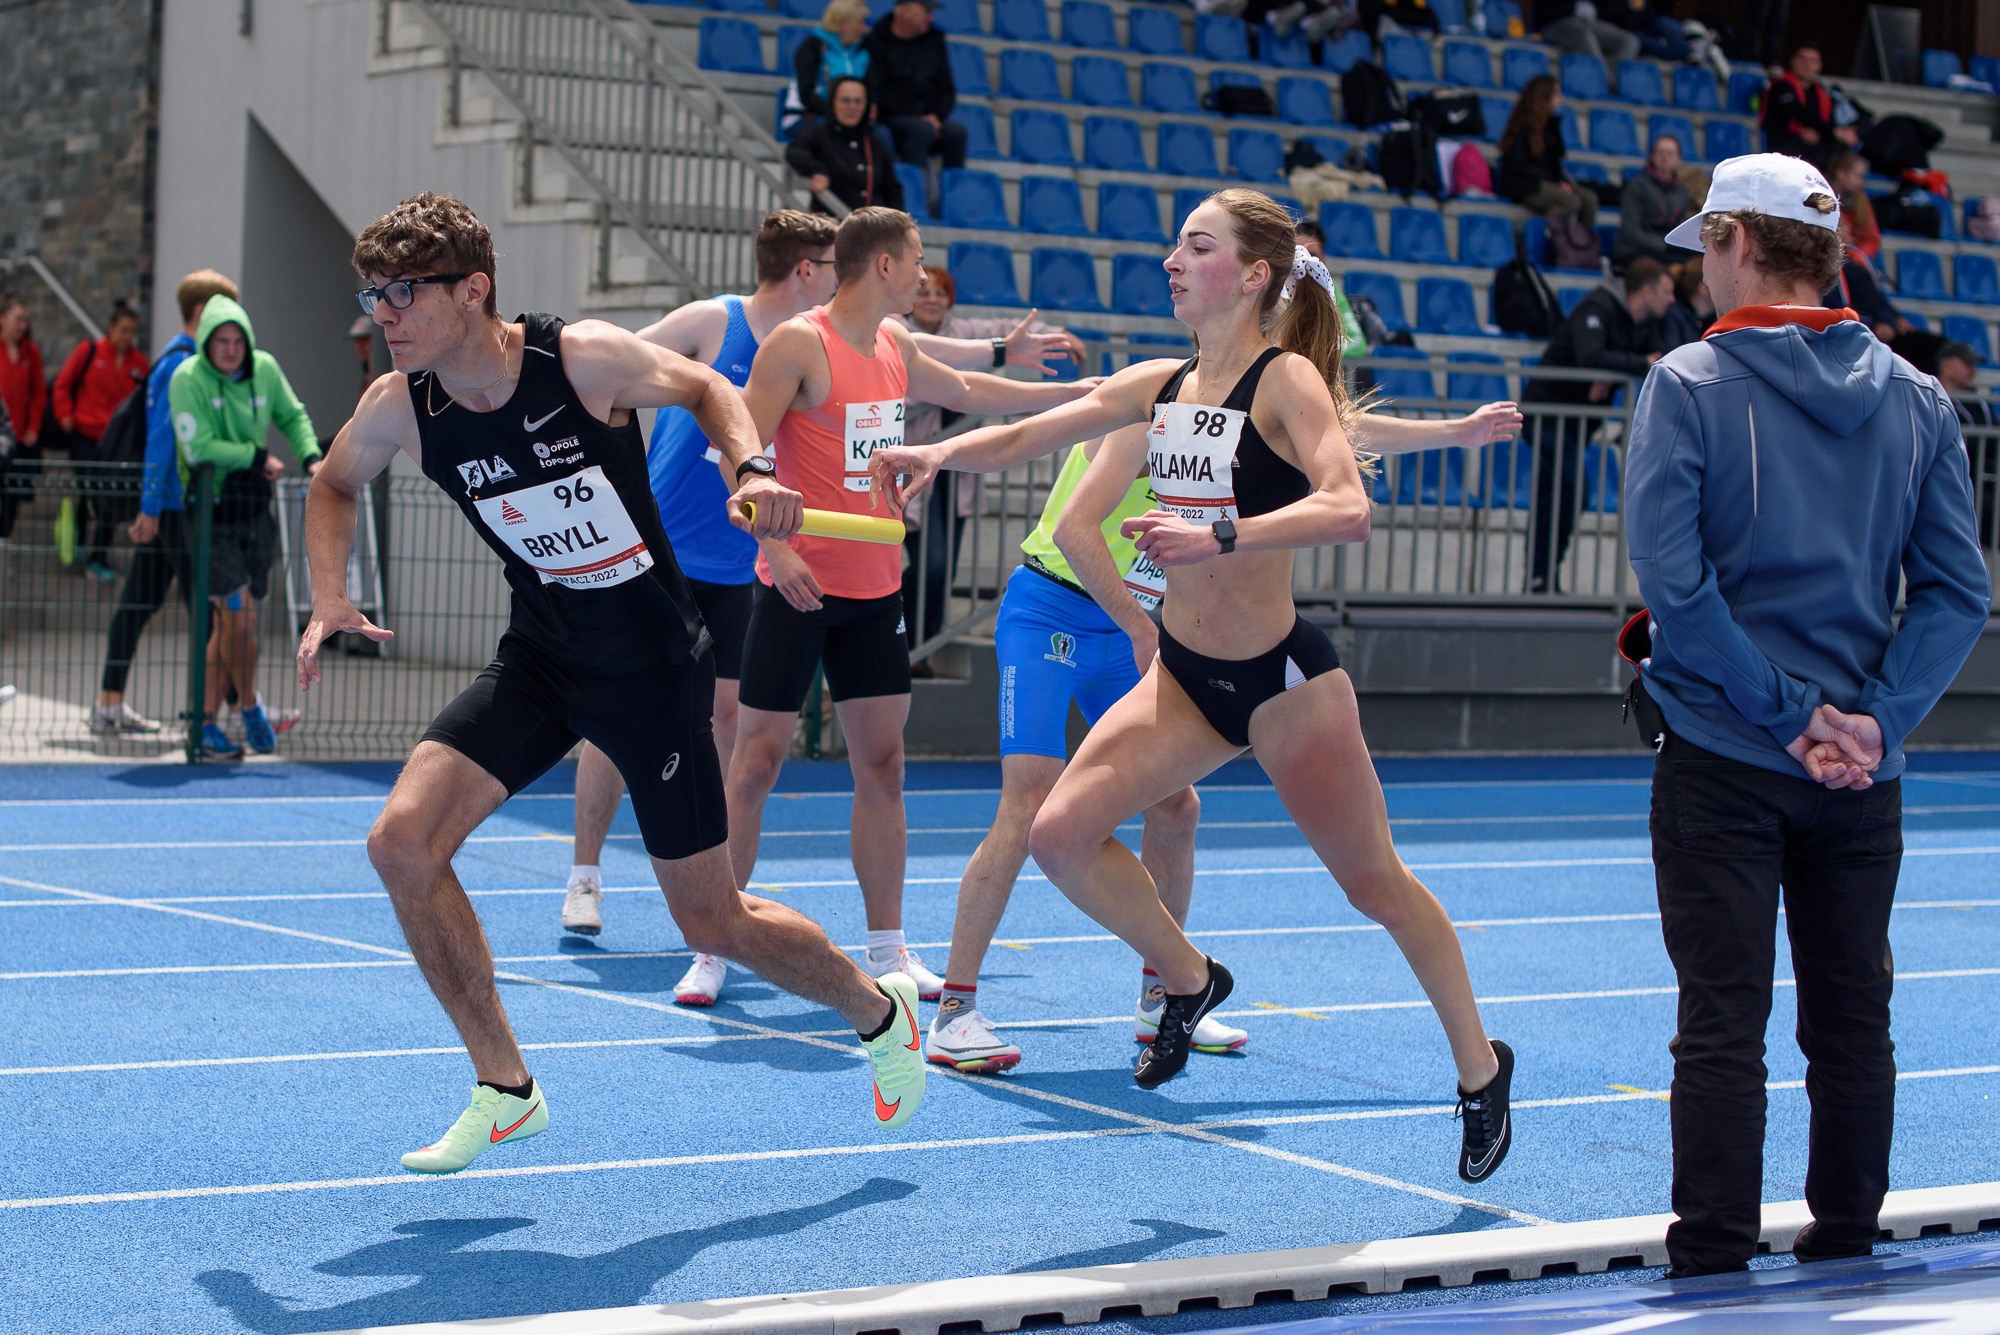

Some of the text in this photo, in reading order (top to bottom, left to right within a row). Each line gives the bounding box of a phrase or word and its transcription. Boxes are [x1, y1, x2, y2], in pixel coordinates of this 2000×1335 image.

[857, 419, 881, 428] ORLEN
[1192, 410, 1227, 438] 98
[550, 438, 580, 452] OPOLE
[1150, 451, 1215, 483] KLAMA
[553, 476, 594, 509] 96
[1180, 508, 1204, 519] 2022
[521, 520, 610, 558] BRYLL
[591, 568, 620, 583] 2022
